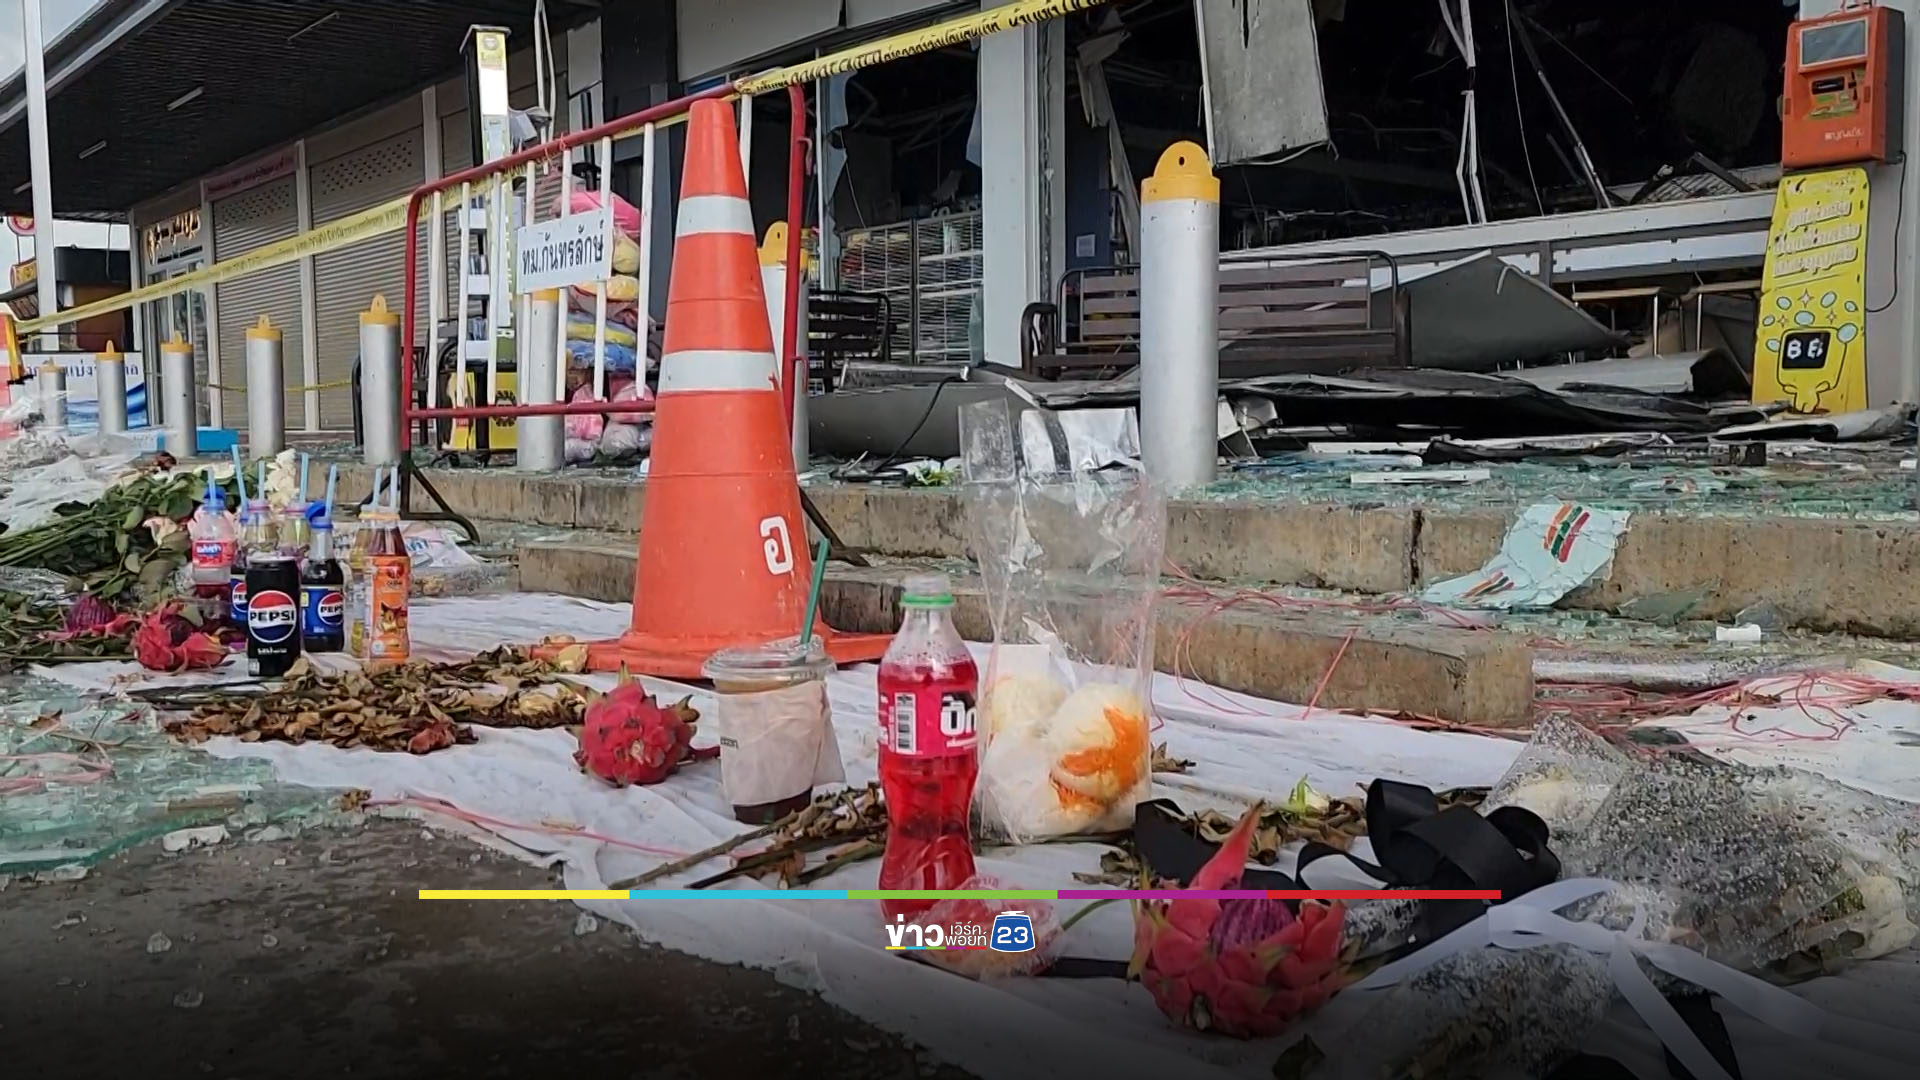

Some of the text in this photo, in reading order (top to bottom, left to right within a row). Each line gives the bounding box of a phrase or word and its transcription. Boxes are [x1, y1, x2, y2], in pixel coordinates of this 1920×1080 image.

[521, 218, 605, 276] ทม.กันทรลักษ์
[249, 609, 294, 623] PEPSI
